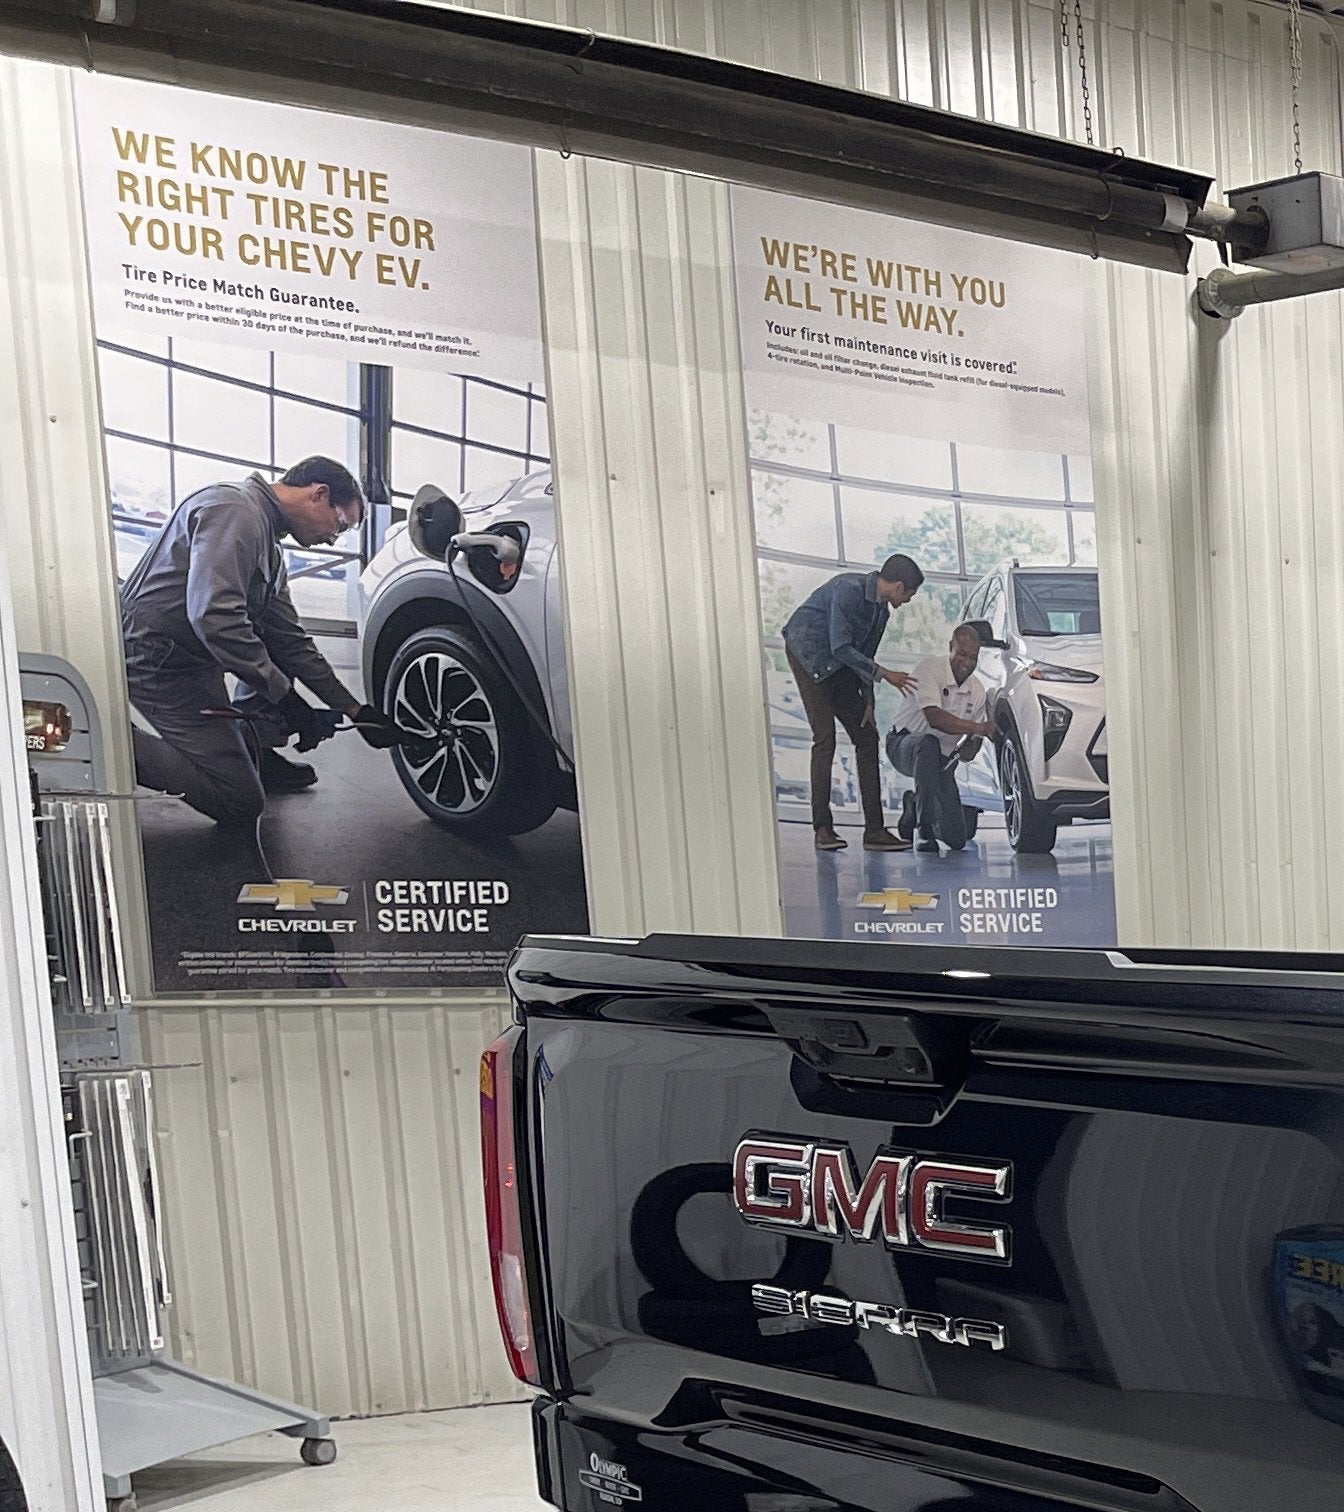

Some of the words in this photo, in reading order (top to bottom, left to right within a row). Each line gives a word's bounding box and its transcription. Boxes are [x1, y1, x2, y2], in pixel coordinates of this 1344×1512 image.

[111, 126, 177, 170] WE
[190, 141, 306, 191] KNOW
[318, 163, 389, 205] THE
[116, 169, 235, 220] RIGHT
[246, 192, 354, 239] TIRES
[367, 211, 435, 252] FOR
[118, 212, 224, 262] YOUR
[238, 233, 363, 281] CHEVY
[376, 253, 430, 291] EV.
[760, 236, 858, 283] WE'RE
[866, 257, 942, 299] WITH
[950, 273, 1005, 309] YOU
[121, 263, 157, 283] Tire
[162, 270, 207, 292] Price
[212, 278, 264, 301] Match
[269, 287, 360, 314] Guarantee.
[764, 274, 822, 313] ALL
[829, 287, 888, 325] THE
[895, 299, 964, 338] WAY.
[124, 288, 159, 302] Provide
[174, 298, 195, 308] with
[204, 301, 234, 313] better
[235, 307, 267, 319] eligible
[269, 312, 292, 322] price
[304, 316, 320, 326] the
[321, 318, 341, 329] time
[353, 324, 396, 337] purchase,
[397, 329, 413, 338] and
[435, 334, 462, 344] match
[125, 300, 146, 312] Find
[155, 305, 185, 318] better
[186, 311, 210, 322] price
[211, 315, 240, 326] within
[255, 321, 276, 331] days
[288, 325, 304, 335] the
[305, 329, 349, 342] purchase,
[349, 334, 366, 343] and
[388, 339, 417, 350] refund
[418, 343, 433, 352] the
[764, 319, 797, 338] Your
[800, 326, 831, 345] first
[834, 336, 918, 360] maintenance
[920, 349, 948, 365] visit
[950, 352, 962, 367] is
[375, 880, 509, 904] CERTIFIED
[958, 888, 1058, 909] CERTIFIED
[238, 918, 357, 933] CHEVROLET
[377, 908, 490, 933] SERVICE
[854, 921, 945, 934] CHEVROLET
[959, 912, 1043, 934] SERVICE
[733, 1137, 1010, 1260] GMC
[751, 1283, 1006, 1350] SIERRA
